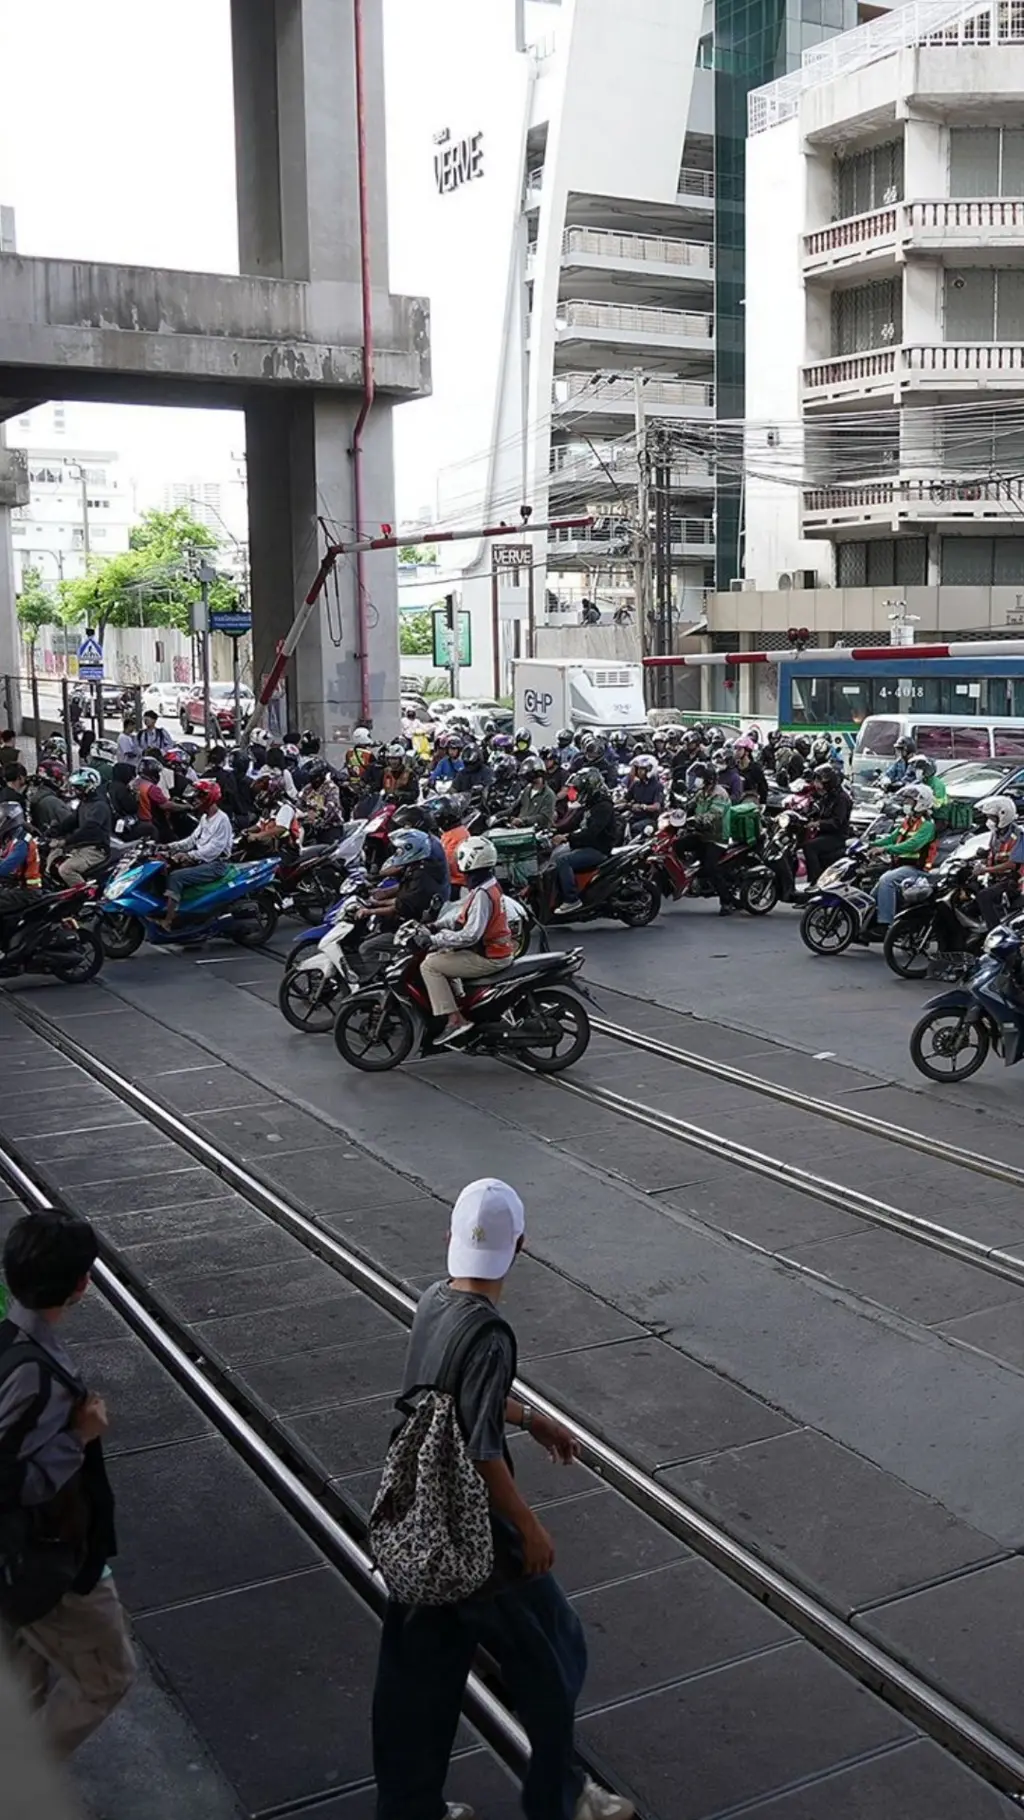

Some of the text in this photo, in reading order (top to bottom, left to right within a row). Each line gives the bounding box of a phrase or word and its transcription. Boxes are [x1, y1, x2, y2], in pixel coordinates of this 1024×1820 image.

[434, 131, 484, 194] VERVE
[494, 550, 531, 564] VERVE
[524, 689, 553, 713] GHP
